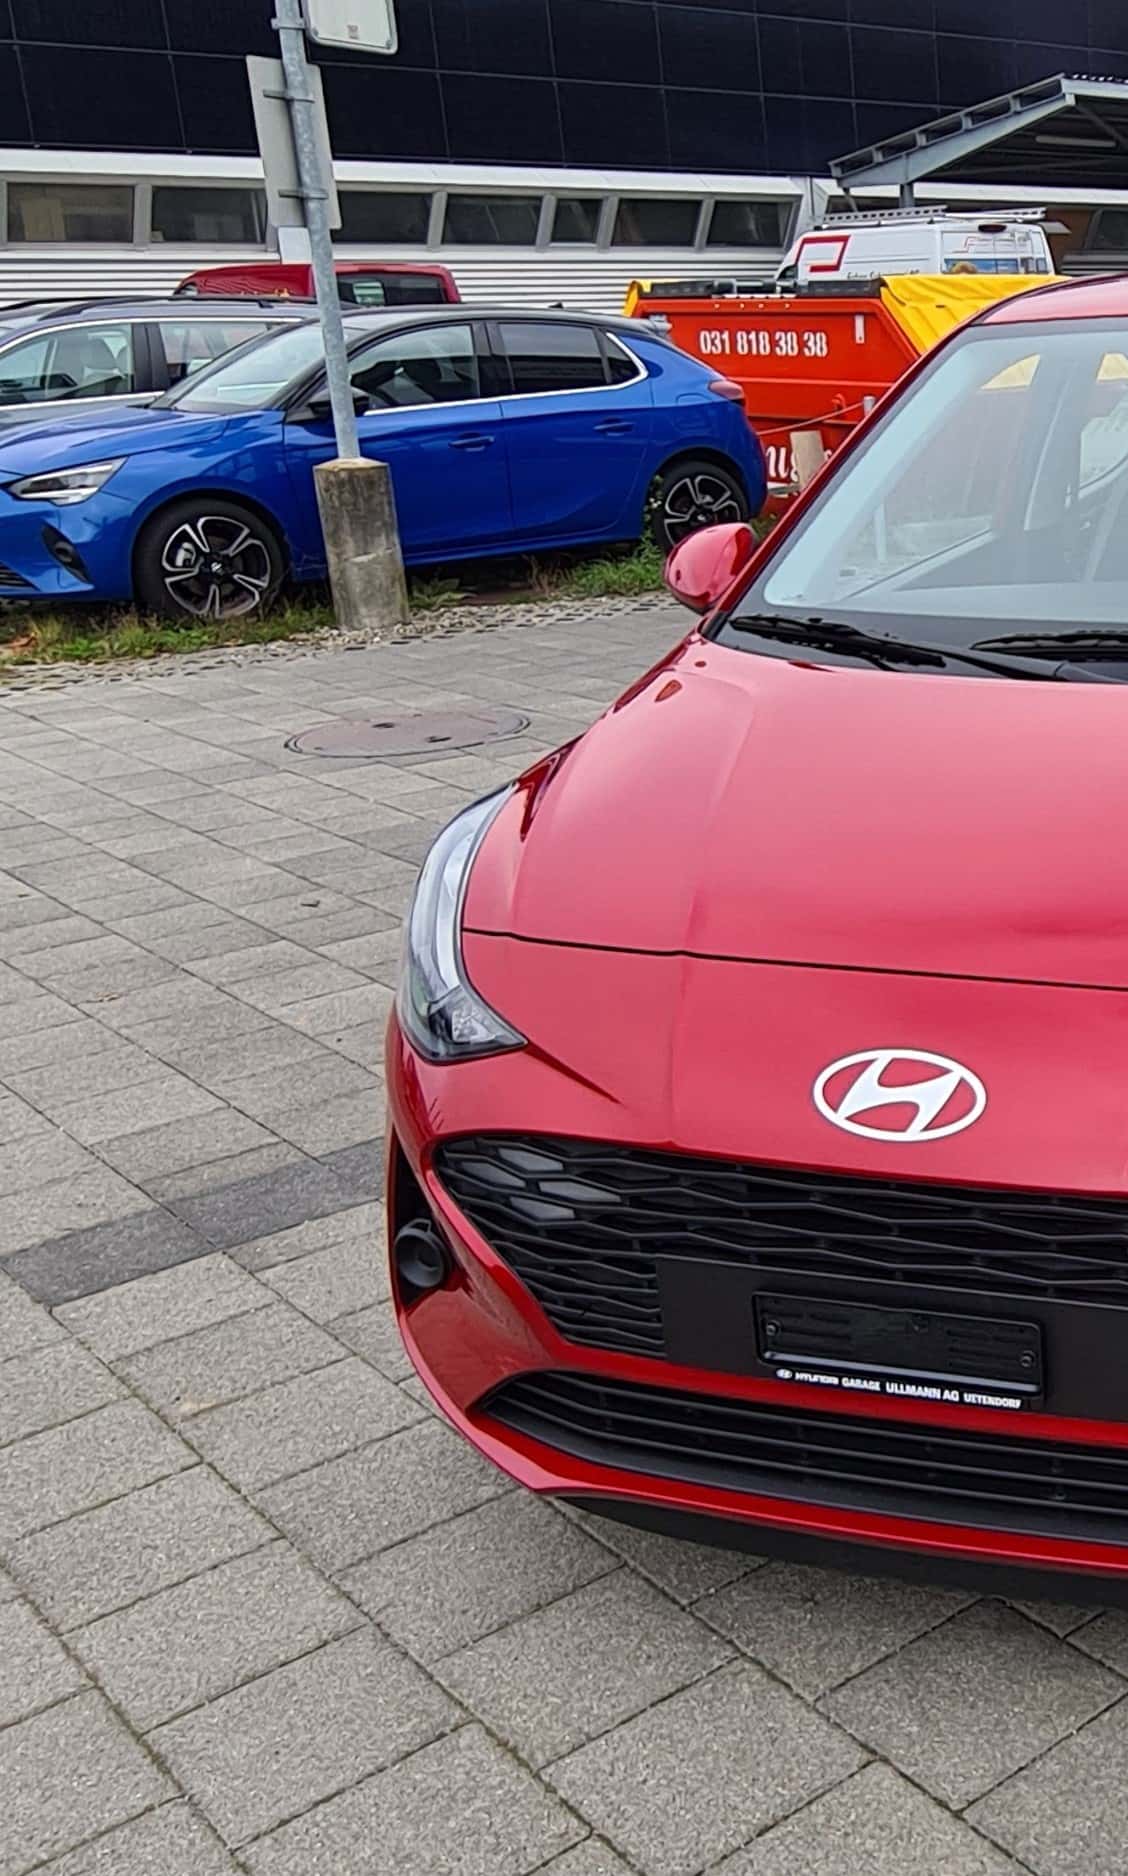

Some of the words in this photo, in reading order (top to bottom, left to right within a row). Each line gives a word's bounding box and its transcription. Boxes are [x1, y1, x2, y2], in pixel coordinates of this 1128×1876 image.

[700, 330, 731, 354] 031
[736, 331, 771, 355] 818
[775, 331, 799, 356] 38
[803, 332, 828, 357] 38
[841, 1377, 881, 1391] GARAGE
[886, 1381, 941, 1399] ULLMANN
[942, 1390, 960, 1402] AG
[963, 1392, 1022, 1409] UETENDORF
